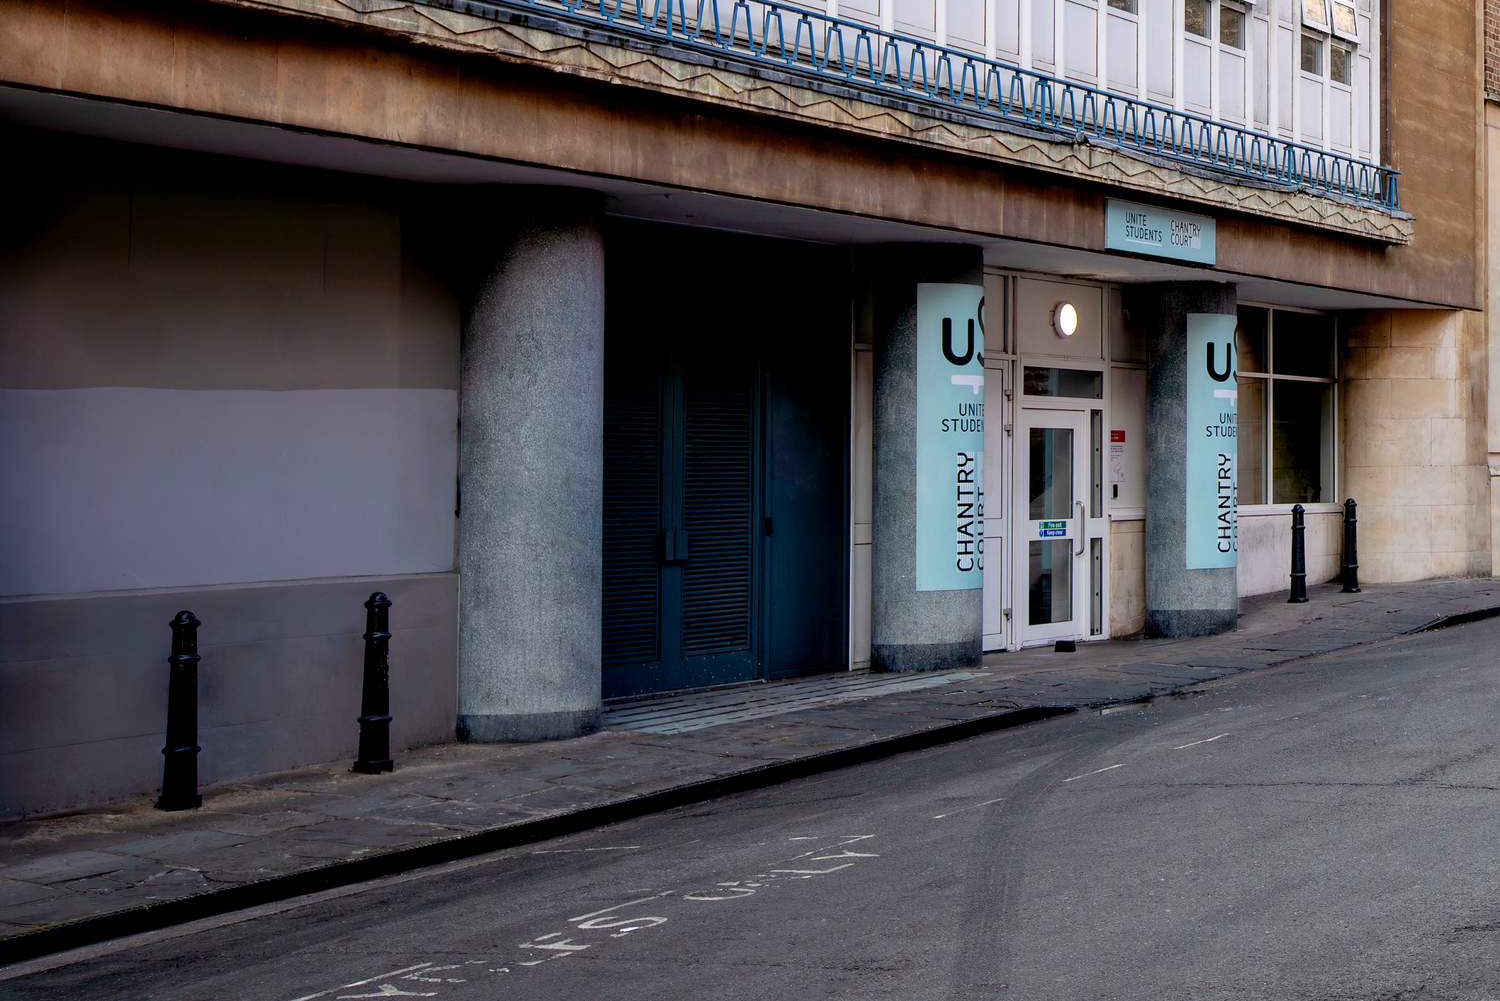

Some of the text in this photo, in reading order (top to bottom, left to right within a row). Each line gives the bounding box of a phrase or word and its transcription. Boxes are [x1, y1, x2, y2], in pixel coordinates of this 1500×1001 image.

[1125, 211, 1147, 227] UNITE
[1125, 225, 1162, 242] STUDENTS
[1170, 220, 1201, 236] CHANTRY
[1170, 233, 1192, 248] COURT
[1217, 453, 1231, 553] CHANTRY
[956, 452, 974, 572] CHANTRY
